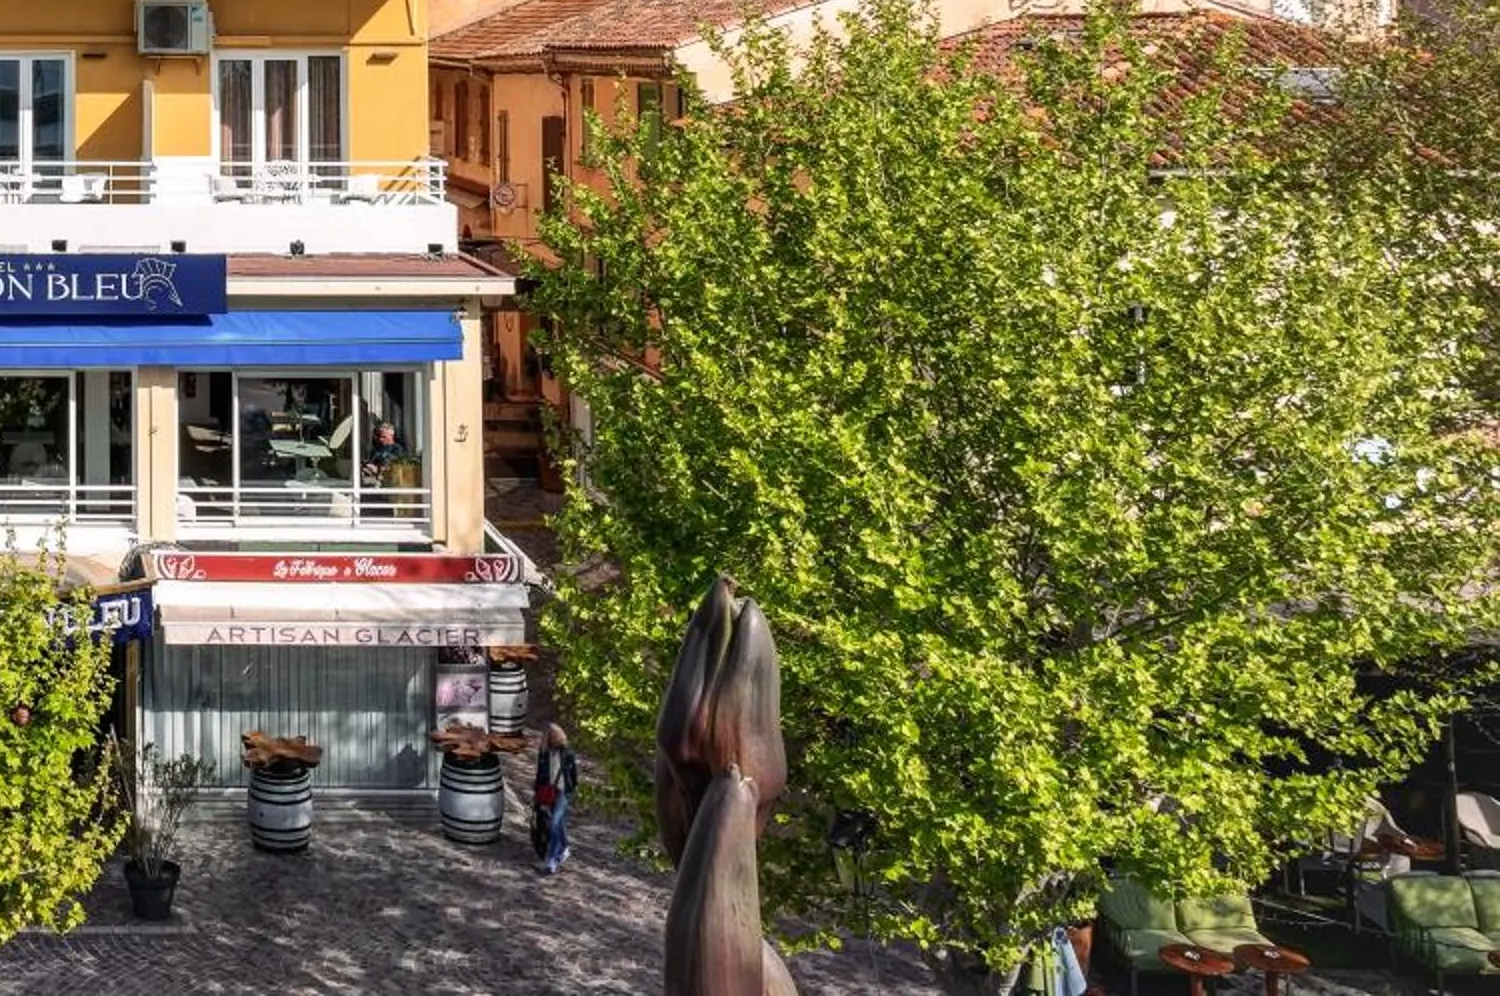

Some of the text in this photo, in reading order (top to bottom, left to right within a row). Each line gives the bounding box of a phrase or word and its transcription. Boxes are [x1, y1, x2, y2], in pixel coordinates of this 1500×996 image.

[47, 273, 145, 301] BLEU
[207, 627, 481, 646] ARTISAN GLACIER
